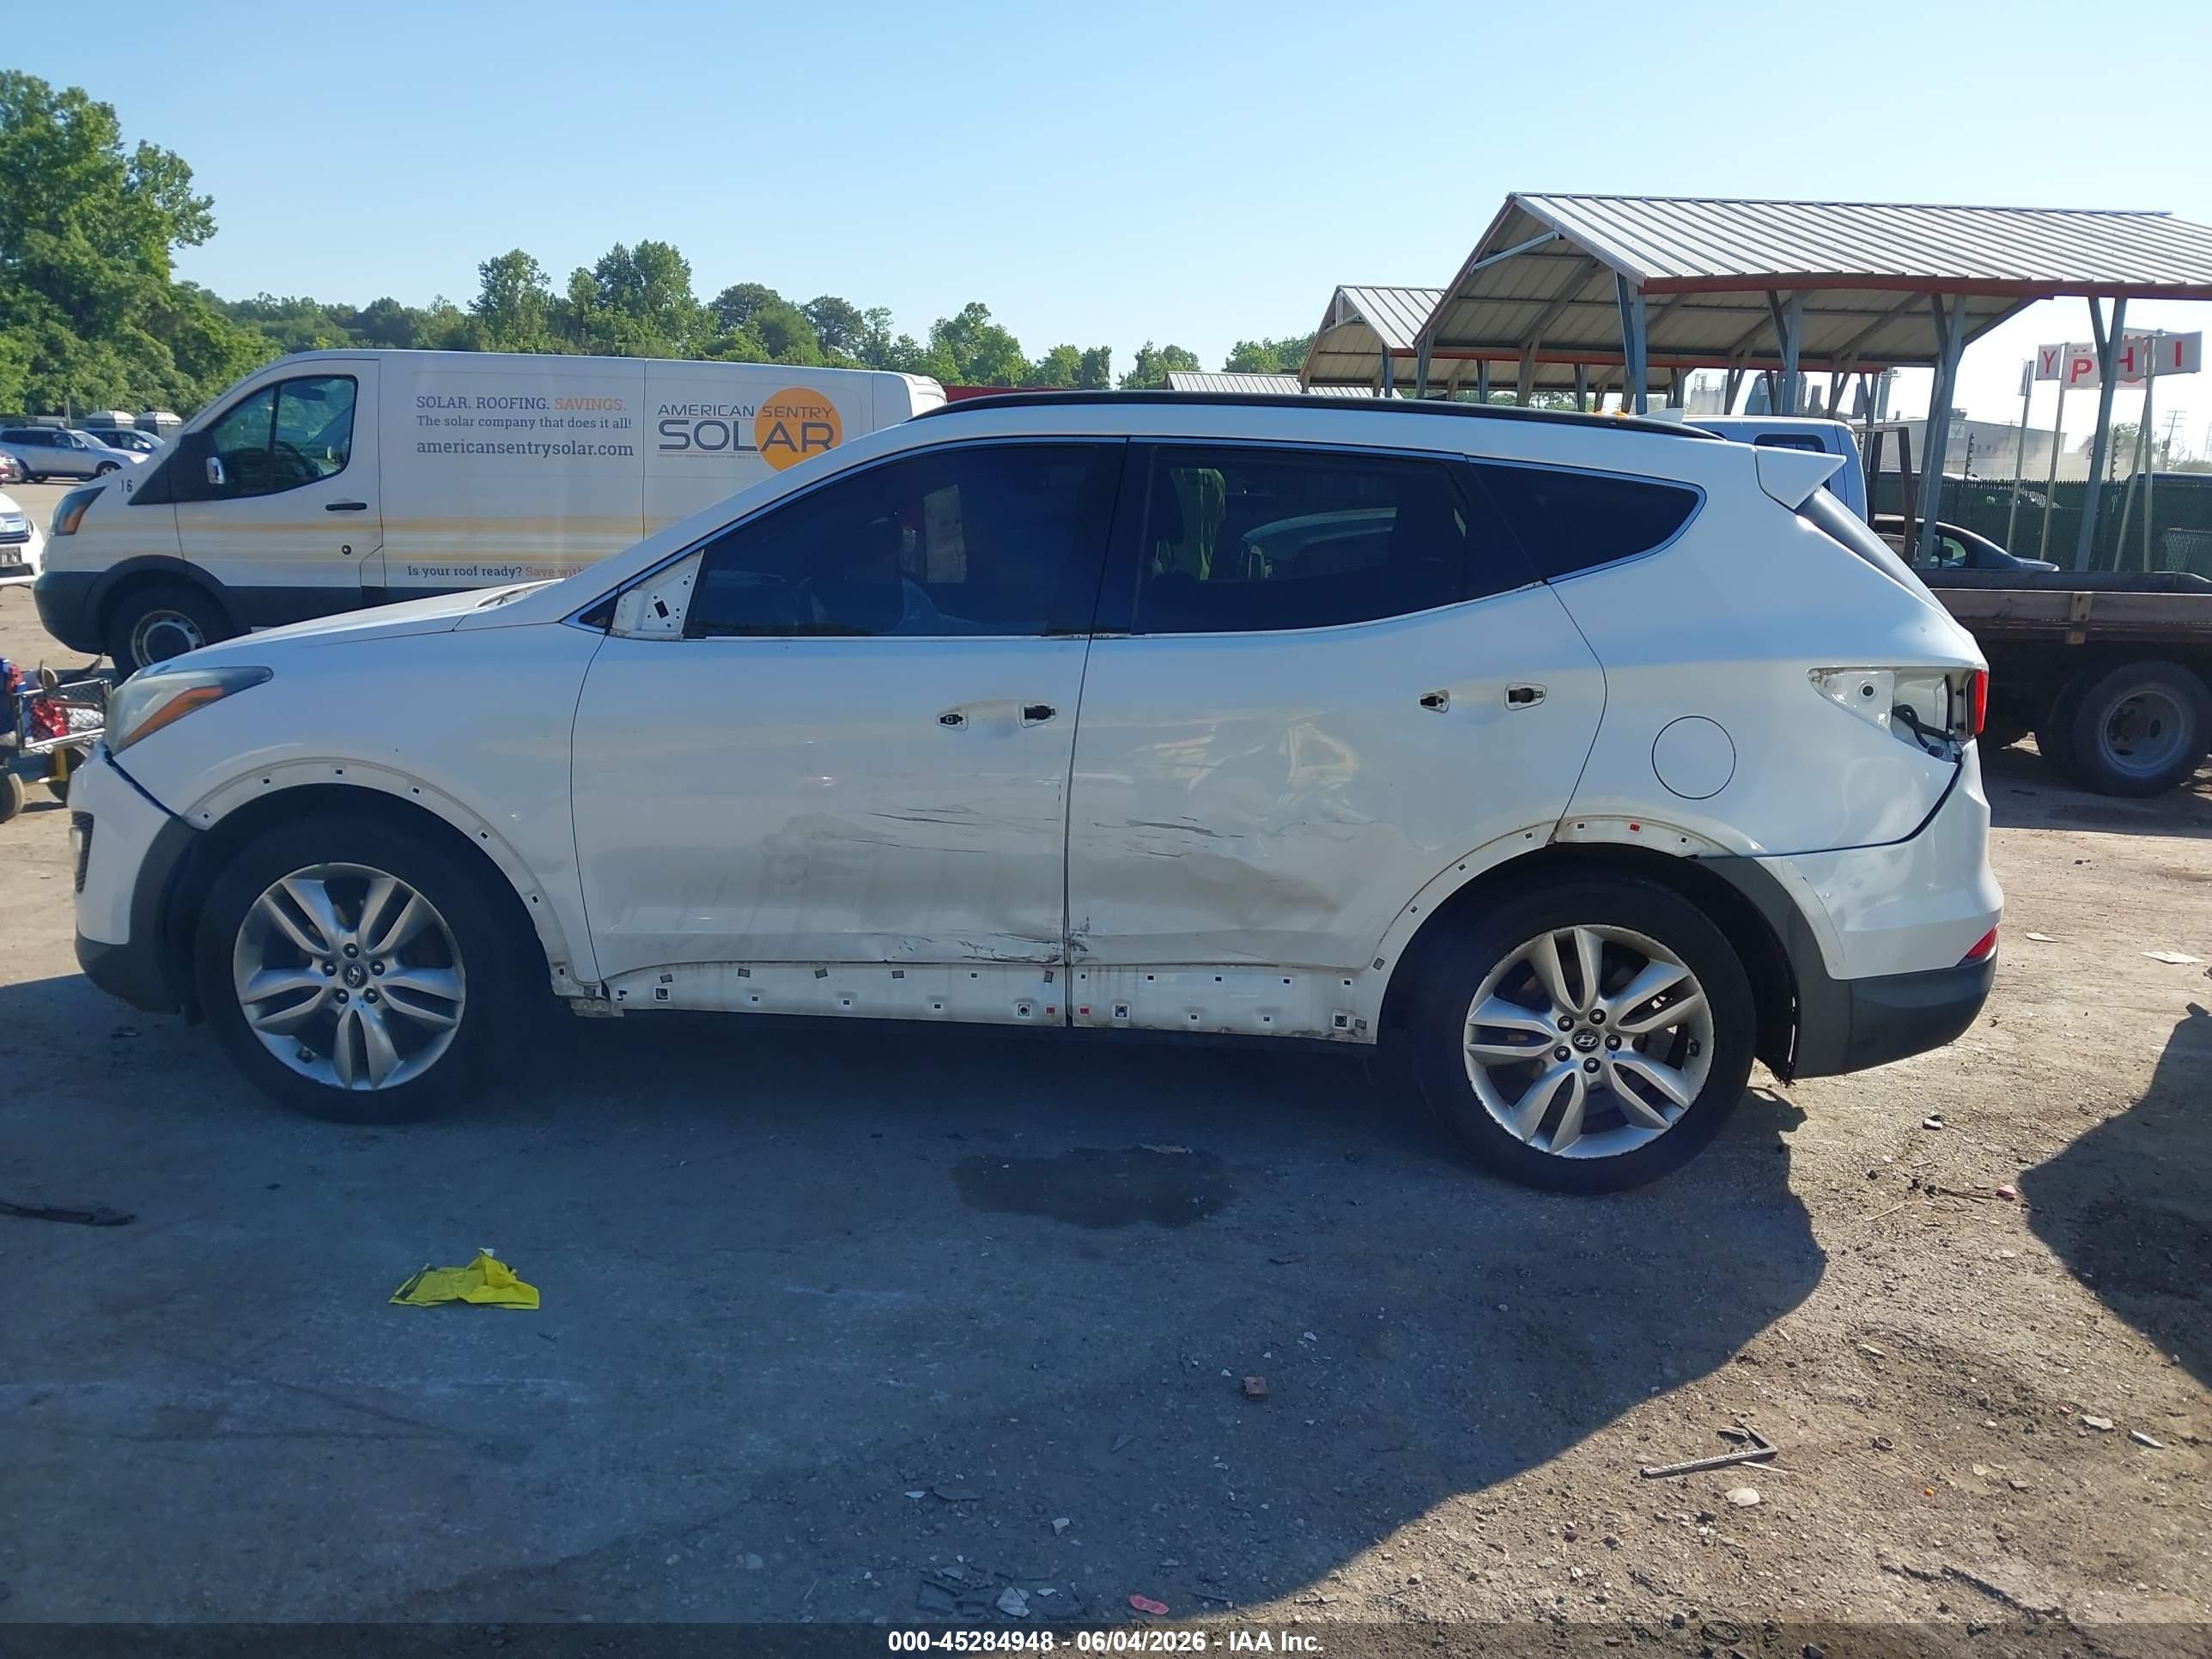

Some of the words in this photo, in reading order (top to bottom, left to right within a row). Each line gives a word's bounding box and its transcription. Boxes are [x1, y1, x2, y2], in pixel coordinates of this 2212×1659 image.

[2070, 359, 2093, 383] P
[416, 396, 471, 409] SOLAR.
[476, 397, 550, 410] ROOFING.
[555, 398, 626, 411] SAVINGS.
[658, 404, 755, 417] AMERICAN
[762, 405, 832, 419] SENTRY
[416, 415, 440, 427] The
[444, 416, 474, 428] solar
[478, 416, 536, 430] company
[539, 416, 564, 428] that
[568, 416, 597, 428] does
[600, 417, 611, 428] it
[612, 417, 632, 429] all!
[658, 419, 835, 453] SOLAR
[416, 439, 635, 458] americansentrysolar.com
[121, 479, 132, 493] 16
[408, 565, 419, 576] Is
[422, 568, 450, 579] your
[453, 565, 478, 576] roof
[482, 566, 523, 579] ready?
[526, 566, 555, 577] Save
